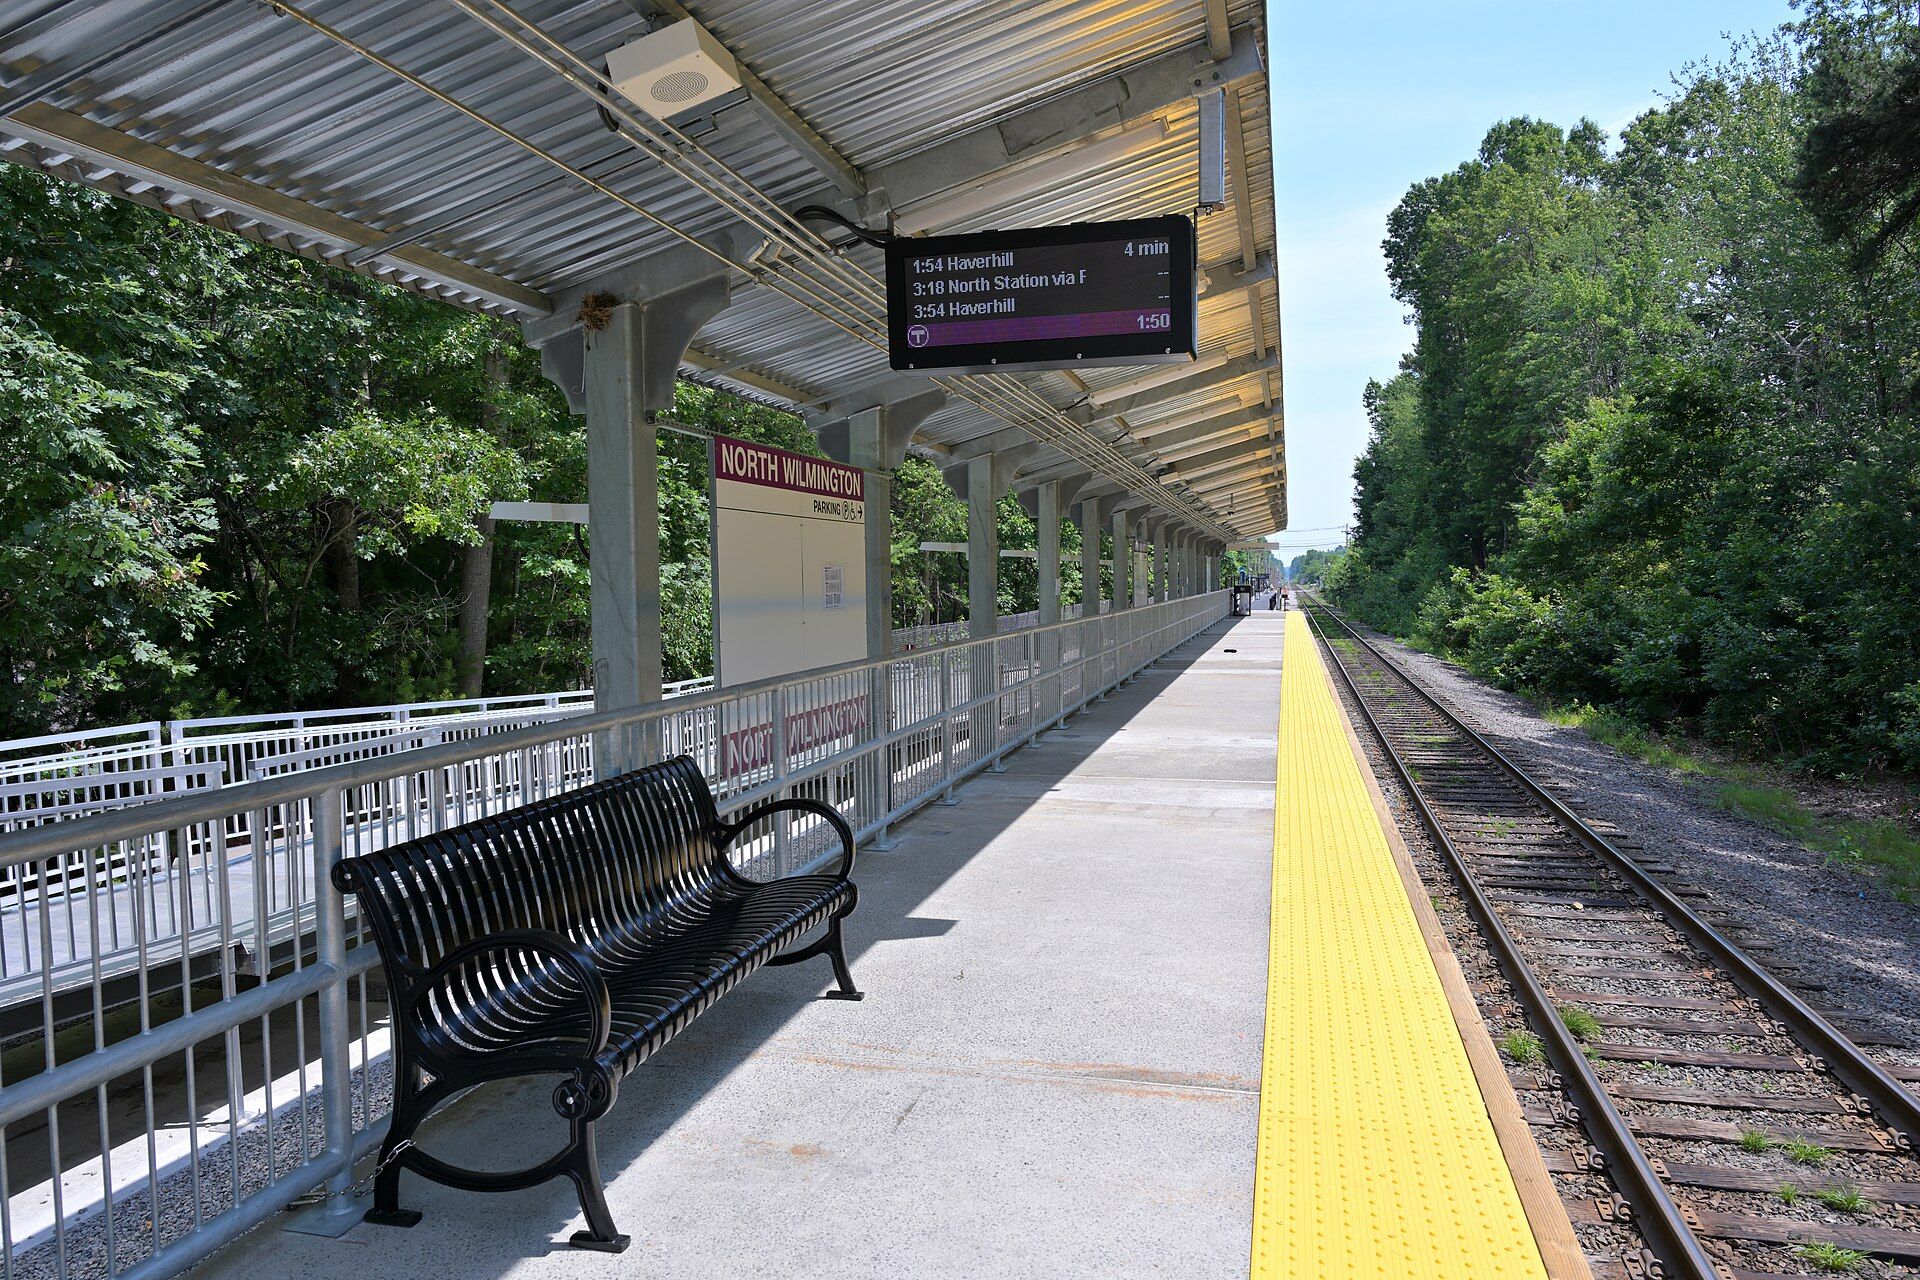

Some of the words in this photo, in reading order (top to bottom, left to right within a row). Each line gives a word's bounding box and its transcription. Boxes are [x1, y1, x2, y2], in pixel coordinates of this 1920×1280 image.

[1124, 242, 1134, 257] 4
[1138, 240, 1169, 256] min
[914, 257, 944, 273] 1:54
[948, 252, 1014, 271] Haverhill
[914, 281, 945, 296] 3:18
[949, 278, 990, 294] North
[995, 272, 1049, 290] Station
[1052, 271, 1075, 287] via
[914, 304, 945, 319] 3:54
[949, 298, 1015, 317] Haverhill
[1137, 313, 1171, 329] 1:50
[721, 443, 778, 482] NORTH
[783, 456, 861, 497] WILMINGTON
[813, 499, 841, 516] PARKING
